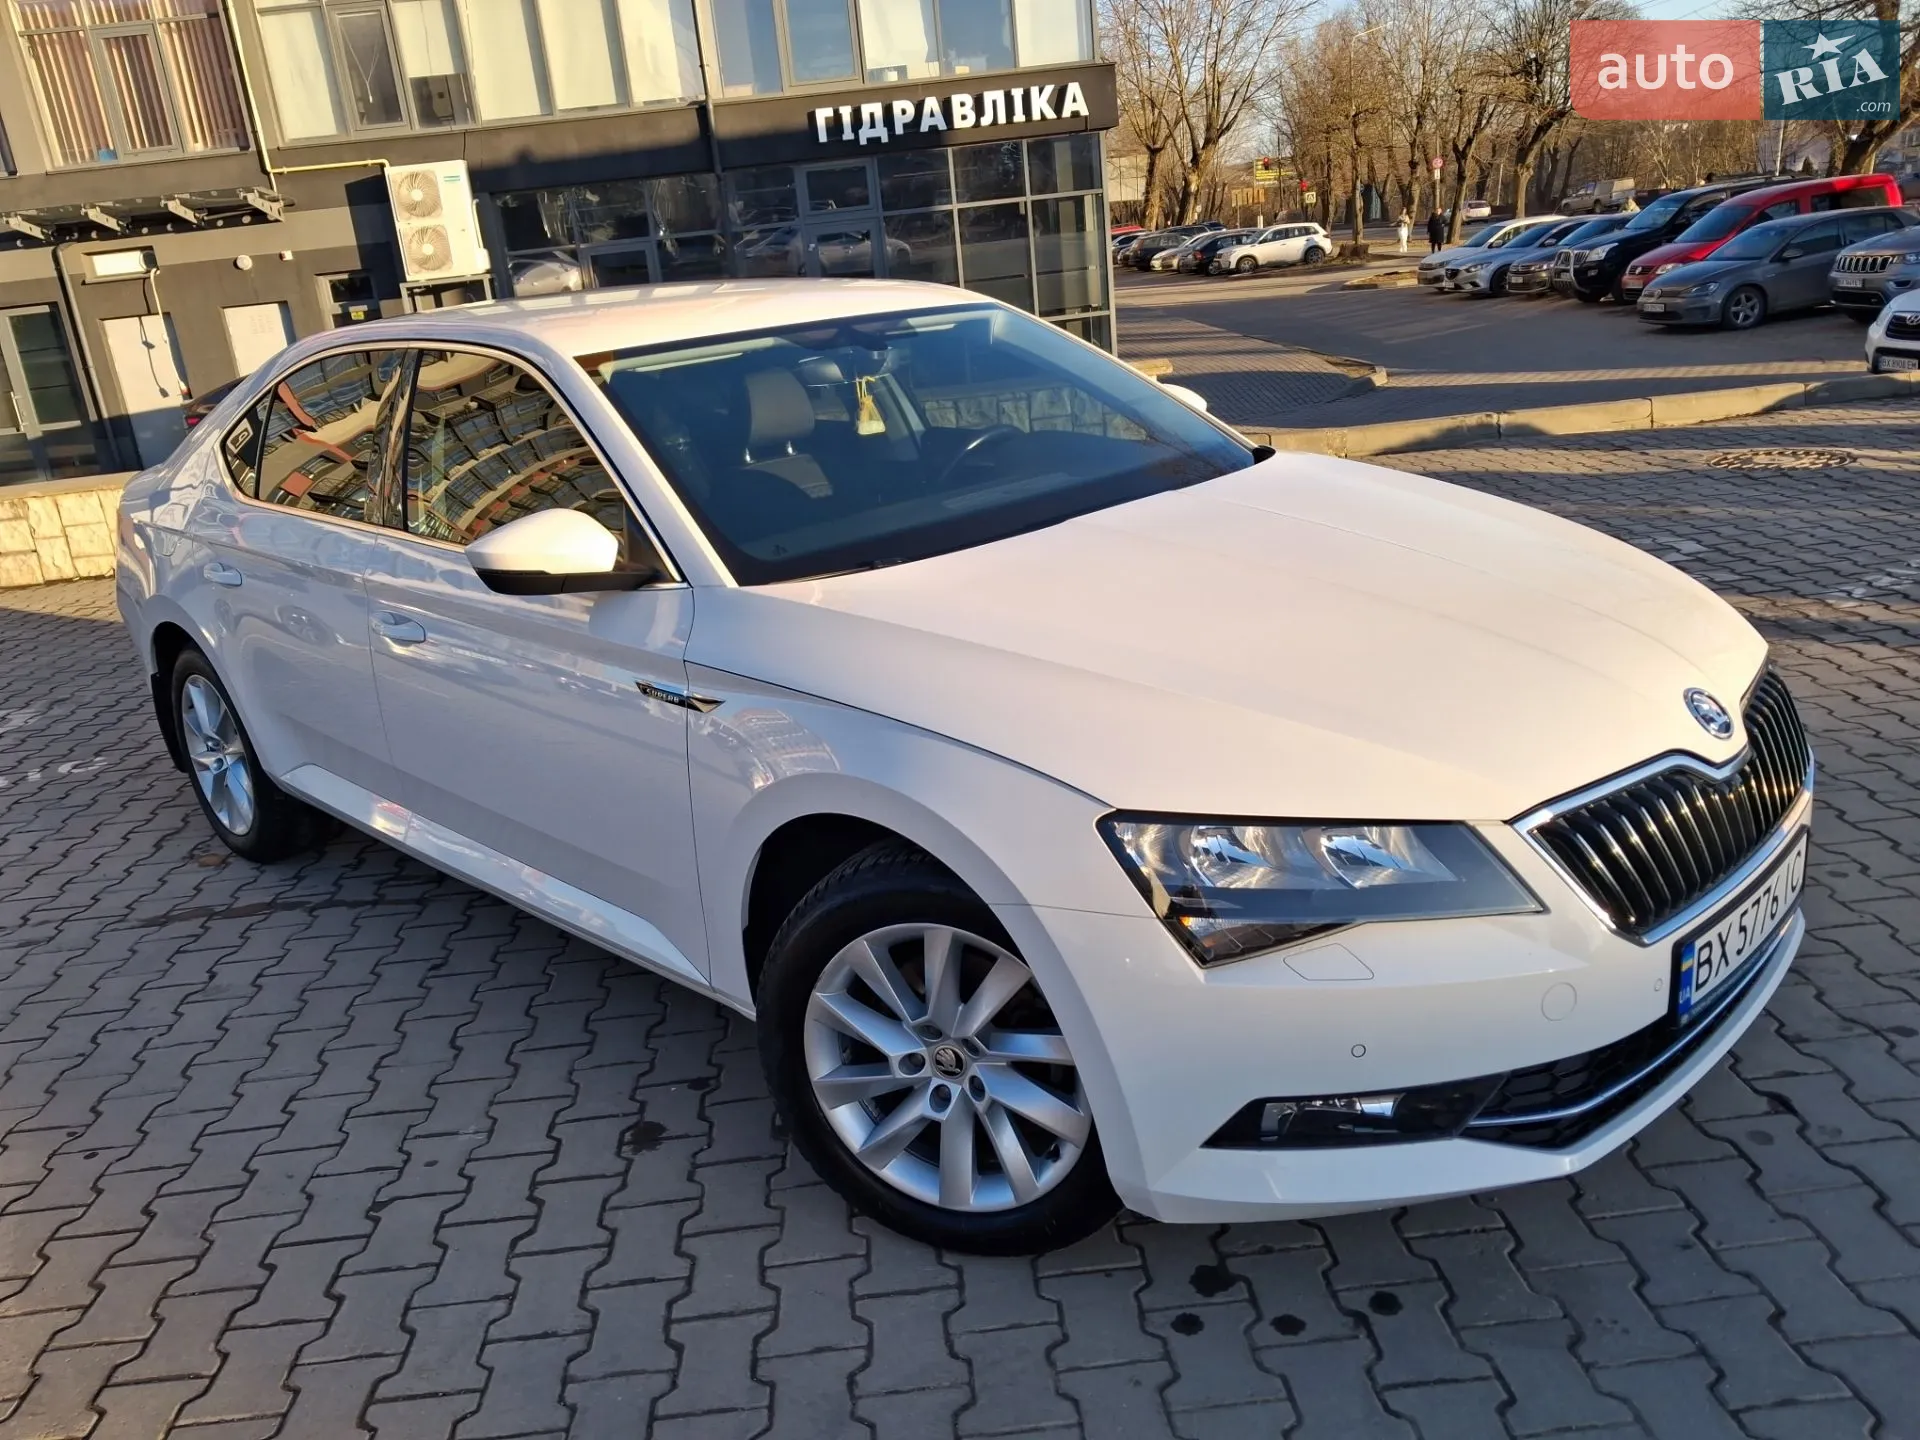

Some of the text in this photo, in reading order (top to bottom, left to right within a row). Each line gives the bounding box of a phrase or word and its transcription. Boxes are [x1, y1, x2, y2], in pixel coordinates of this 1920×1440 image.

[815, 81, 1090, 146] ГІДРАВЛІКА
[1695, 922, 1732, 993] BX
[1736, 875, 1779, 956] 5776
[1784, 850, 1802, 906] IC
